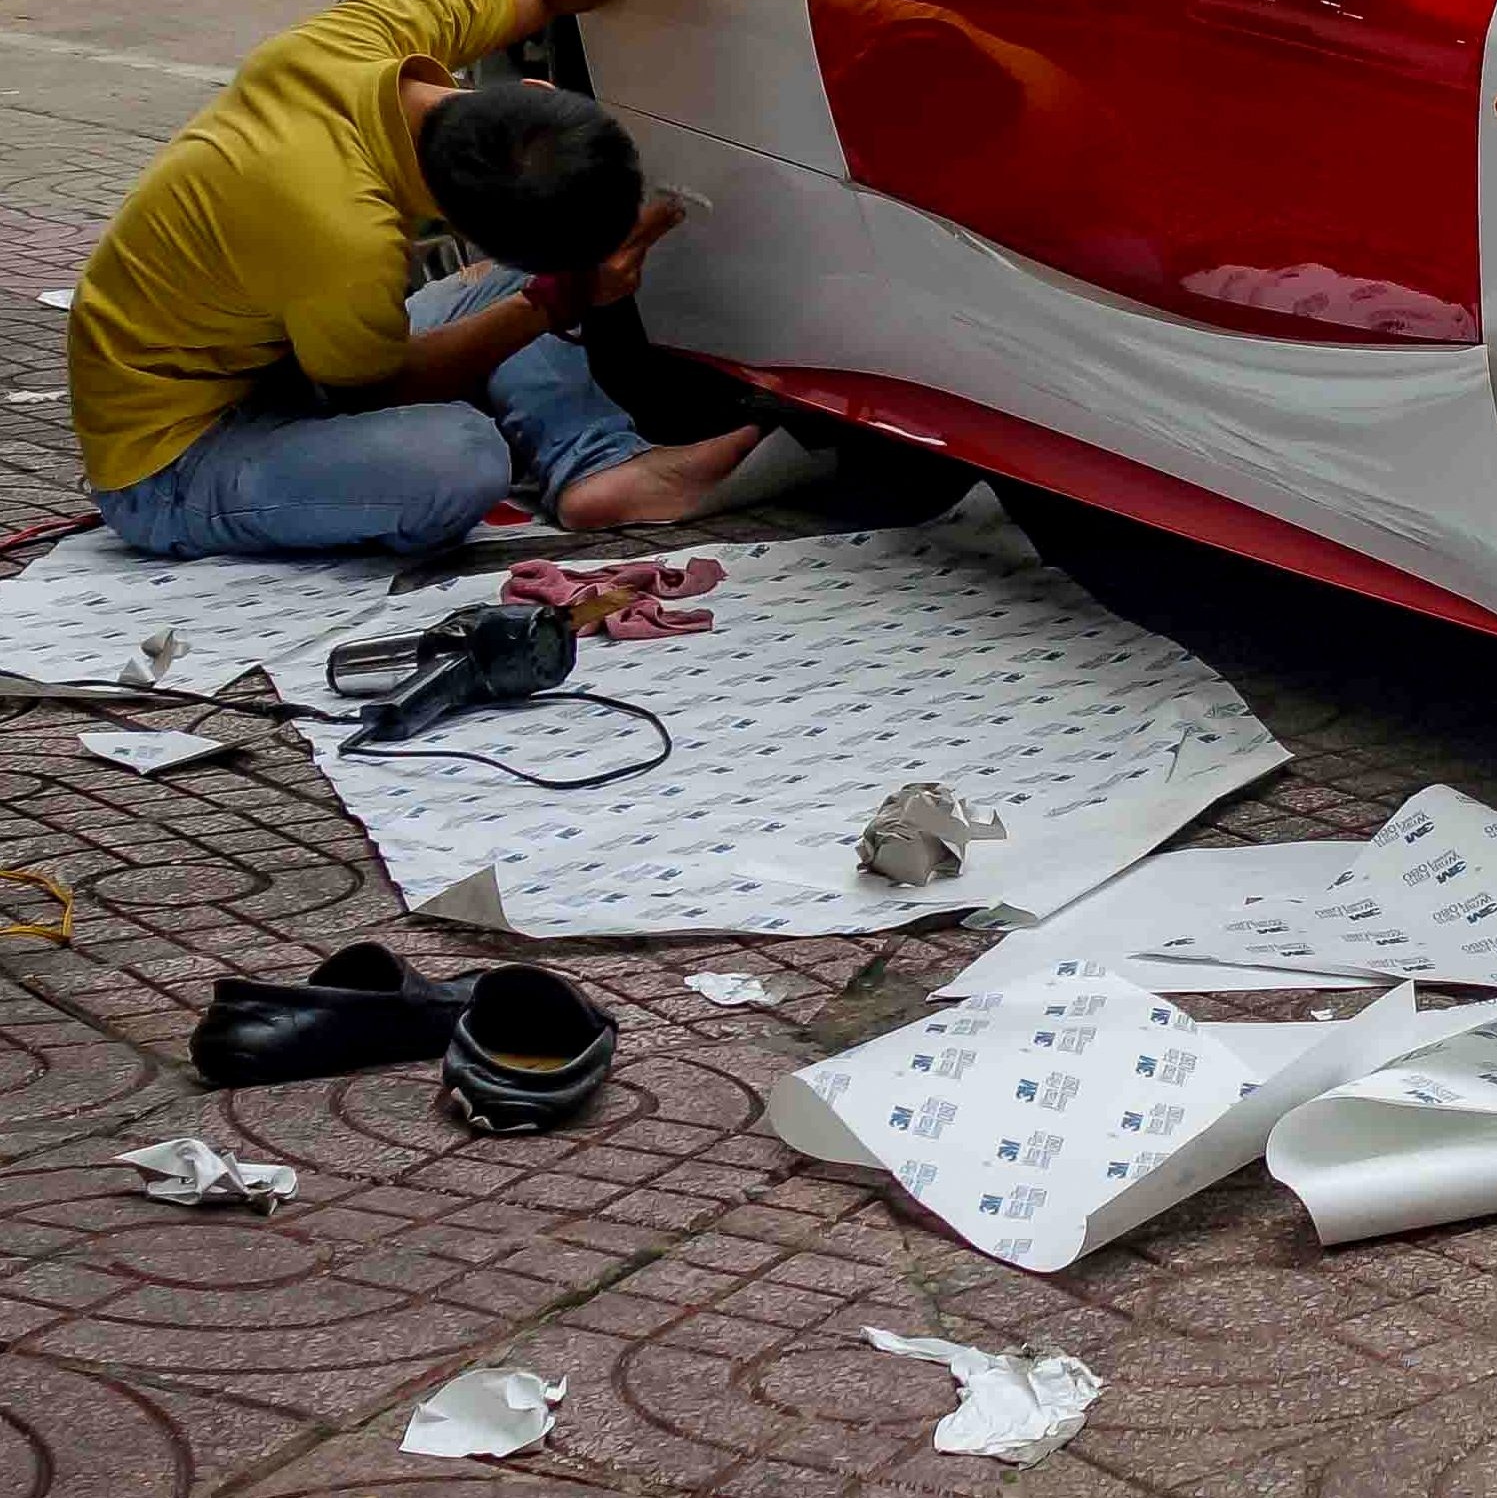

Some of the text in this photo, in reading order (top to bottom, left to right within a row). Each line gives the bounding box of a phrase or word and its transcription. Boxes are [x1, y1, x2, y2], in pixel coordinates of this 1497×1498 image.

[1435, 860, 1467, 884] 3M
[1466, 902, 1497, 925] 3M
[1136, 1054, 1158, 1078] 3M
[1016, 1078, 1040, 1103] 3M
[889, 1105, 914, 1131] 3M
[1121, 1110, 1144, 1132] 3M
[997, 1138, 1021, 1162] 3M
[979, 1193, 1003, 1216] 3M
